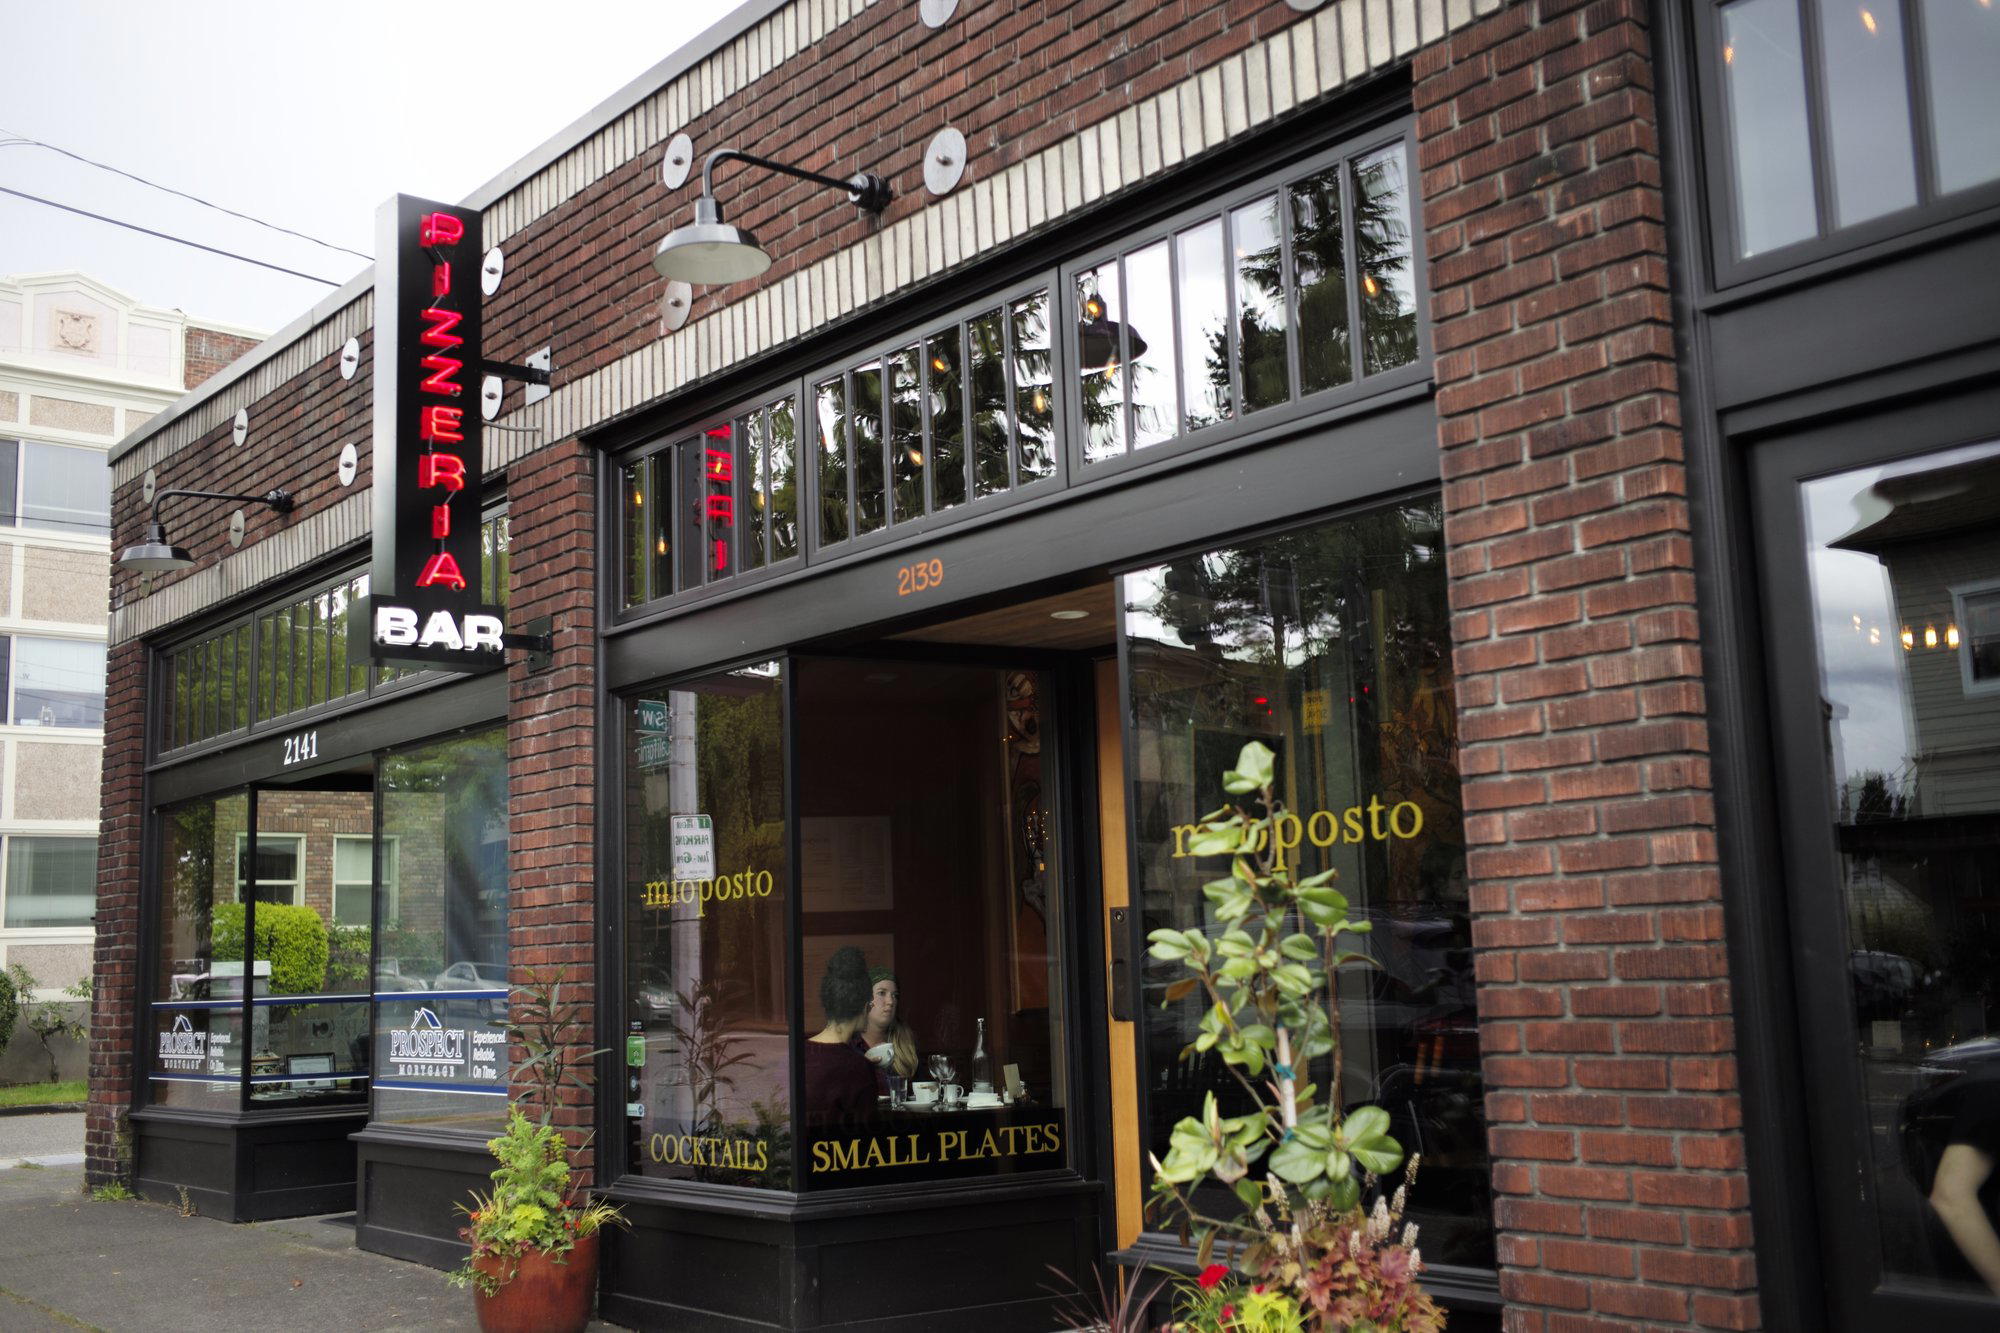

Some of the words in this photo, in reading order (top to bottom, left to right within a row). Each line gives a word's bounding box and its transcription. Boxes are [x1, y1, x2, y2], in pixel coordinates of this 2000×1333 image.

[416, 211, 466, 592] PIZZERIA
[898, 558, 943, 596] 2139
[374, 606, 504, 654] BAR
[284, 731, 318, 765] 2141
[646, 865, 773, 917] mioposto
[160, 1031, 206, 1054] PROSPECT
[389, 1029, 464, 1058] PROSPECT
[399, 1064, 455, 1077] MORTGAGE
[473, 1065, 482, 1079] On
[650, 1133, 768, 1172] COCKTAILS
[811, 1133, 931, 1174] SMALL
[937, 1122, 1061, 1162] PLATES
